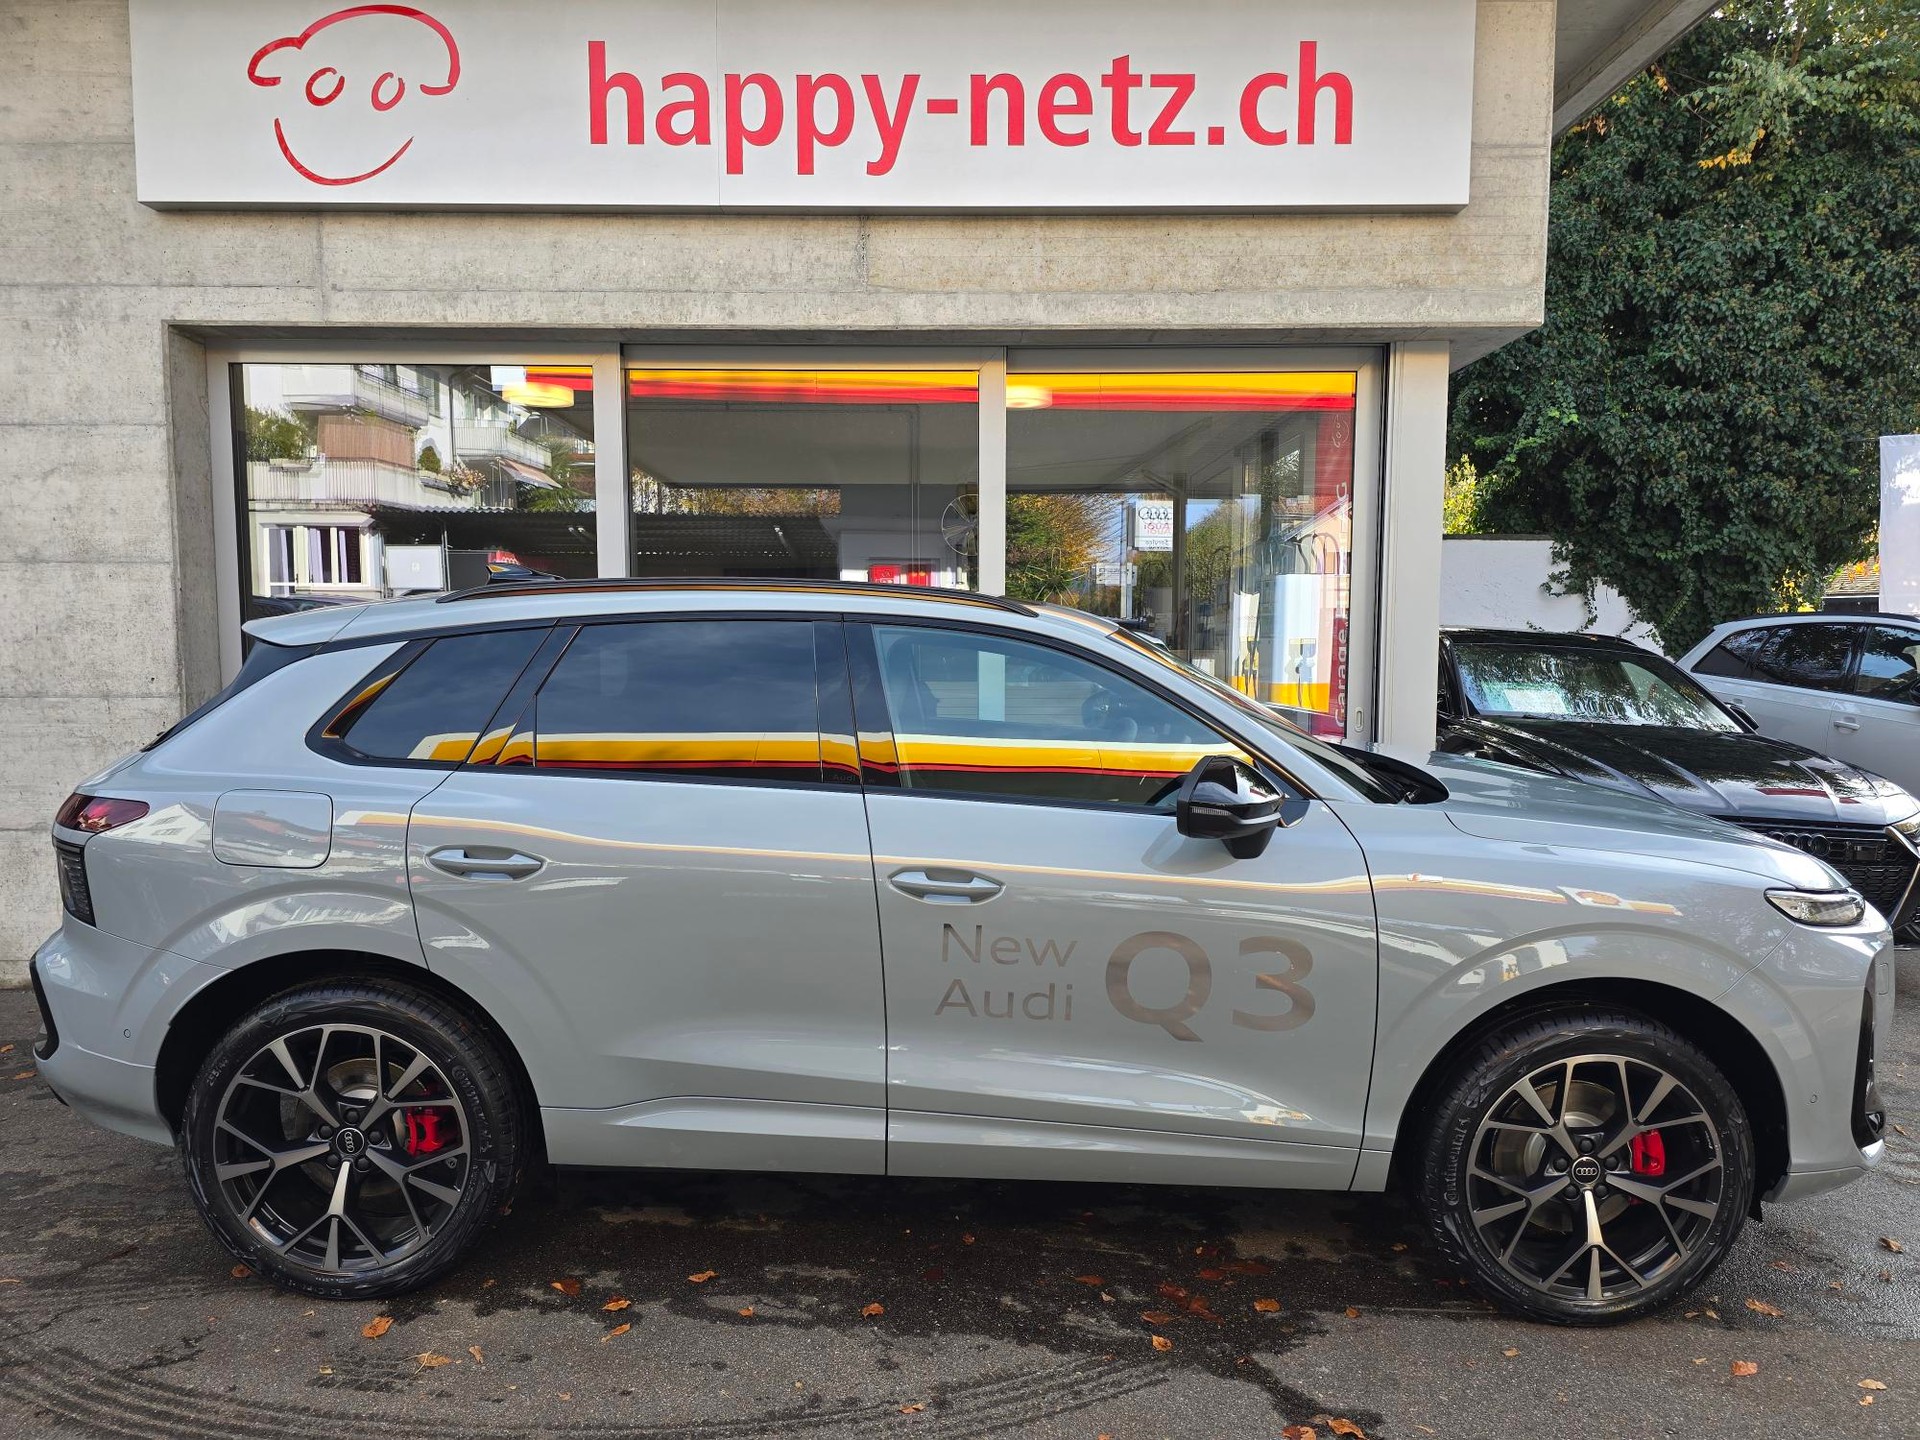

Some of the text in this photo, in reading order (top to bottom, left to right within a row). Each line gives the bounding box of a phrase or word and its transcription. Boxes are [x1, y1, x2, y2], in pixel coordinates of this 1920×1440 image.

[587, 40, 1354, 176] happy-netz.ch
[1335, 628, 1348, 728] Garage
[941, 922, 1078, 968] New
[1105, 930, 1316, 1043] Q3
[934, 978, 1073, 1021] Audi
